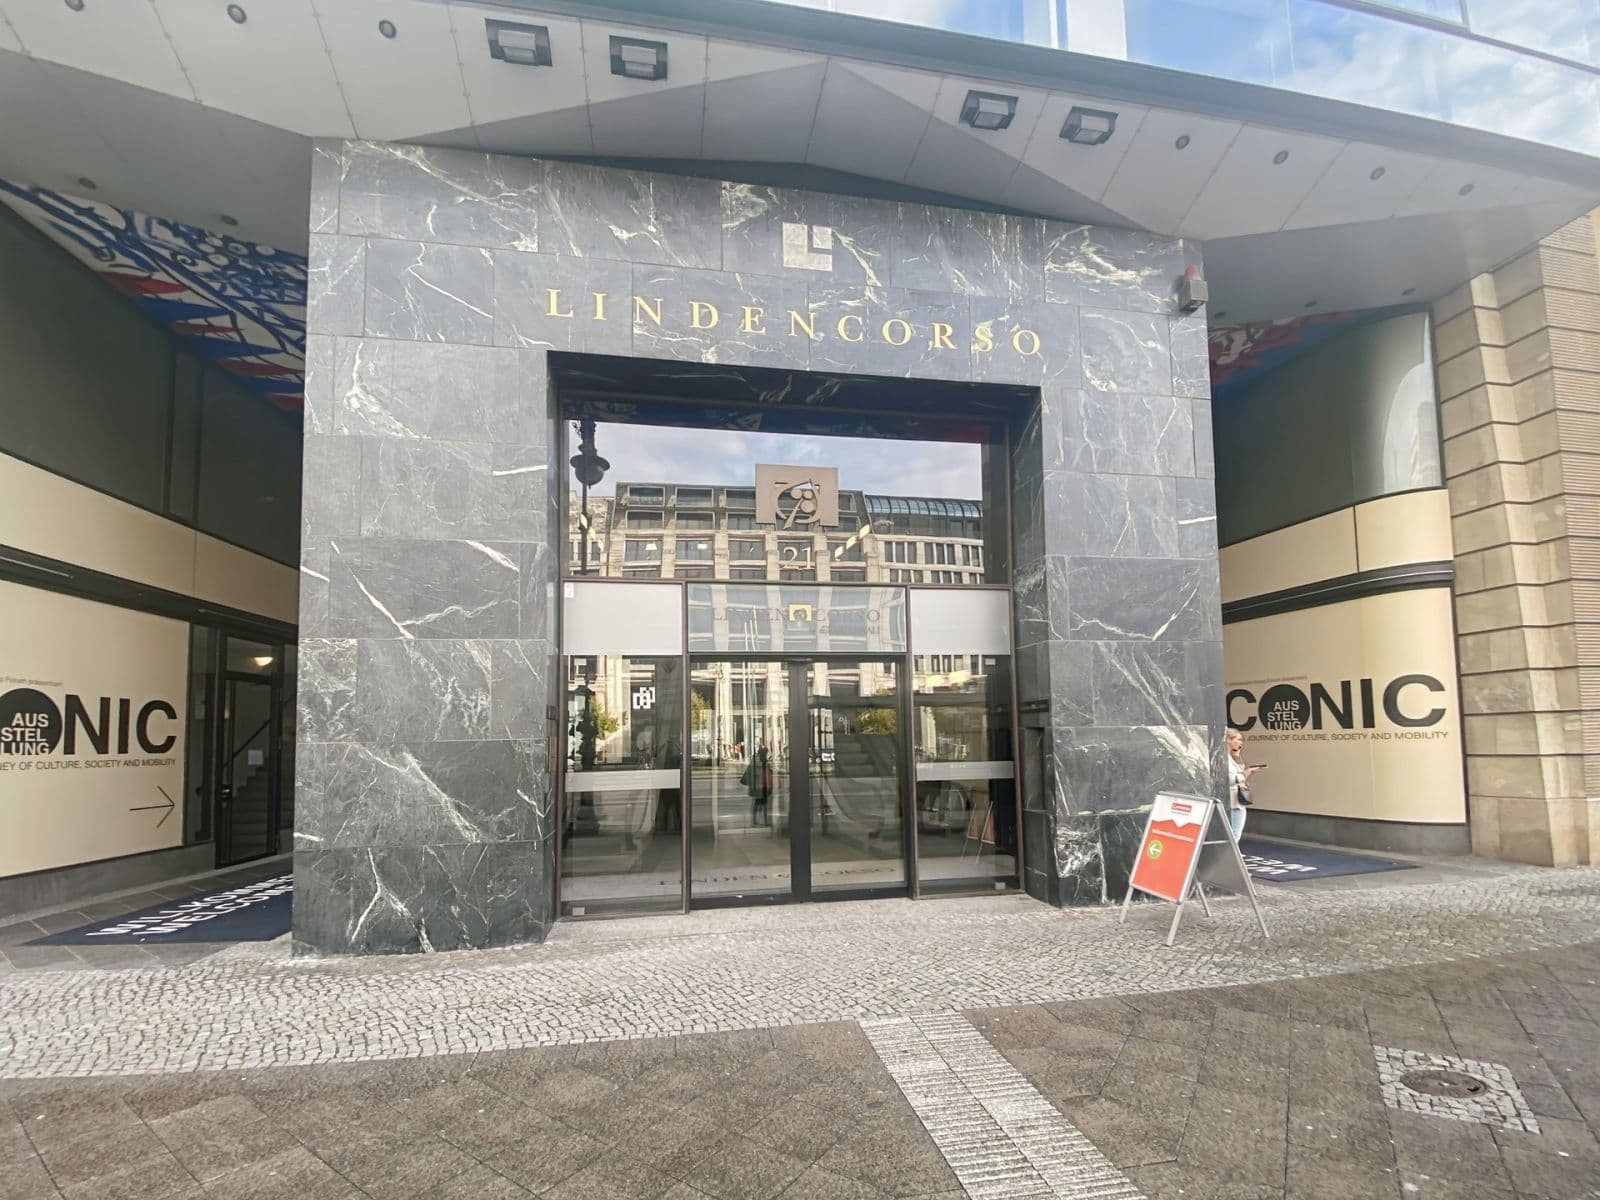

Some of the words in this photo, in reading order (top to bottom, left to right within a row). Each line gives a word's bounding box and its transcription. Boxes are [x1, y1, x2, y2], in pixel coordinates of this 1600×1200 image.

[546, 288, 1041, 355] LINDENCORSO
[782, 546, 815, 570] 21
[1273, 700, 1299, 711] AUS
[12, 712, 49, 727] AUS
[1267, 711, 1298, 722] STEL
[1267, 722, 1301, 731] LUNG
[1, 727, 47, 742] STEL
[1247, 734, 1280, 742] JOURNEY
[1332, 733, 1368, 741] SOCIETY
[1370, 732, 1392, 740] AND
[1395, 731, 1448, 740] MOBILITY
[0, 742, 50, 756] LUNG
[19, 761, 33, 771] OF
[85, 759, 121, 769] SOCIETY
[123, 758, 140, 768] AND
[142, 758, 177, 767] MOBILITY
